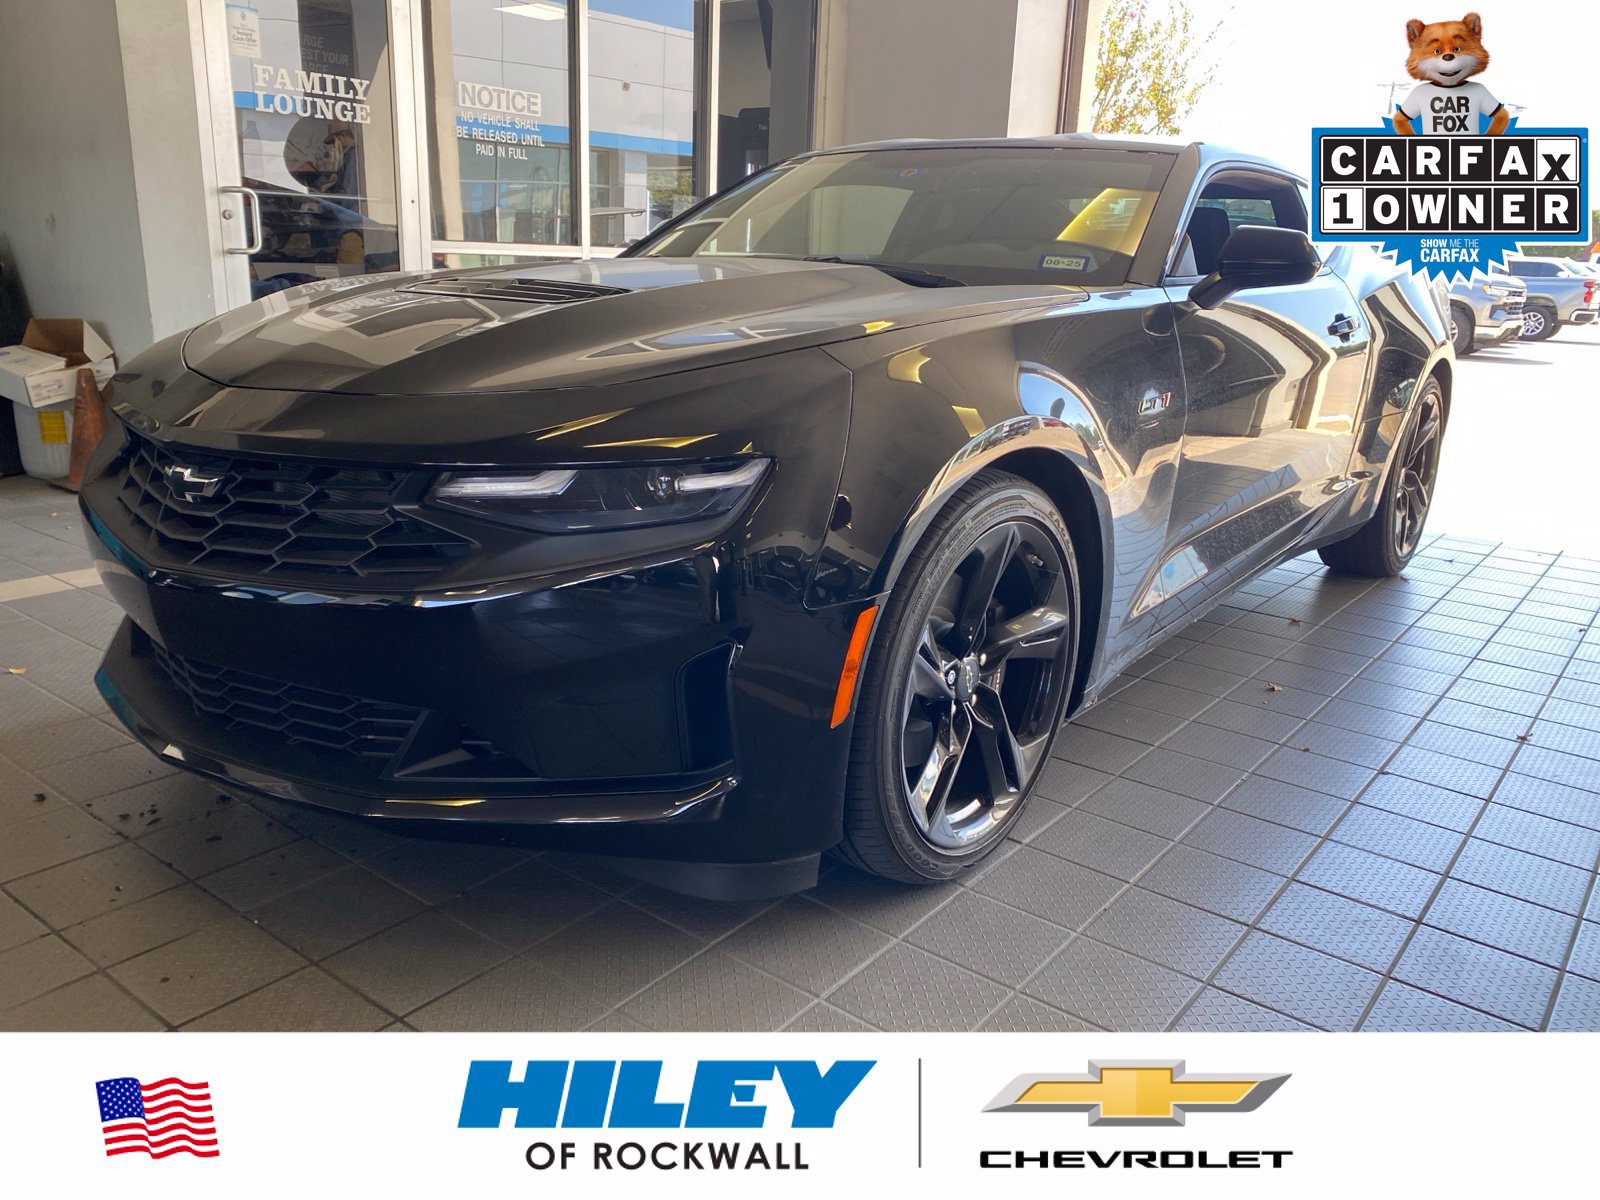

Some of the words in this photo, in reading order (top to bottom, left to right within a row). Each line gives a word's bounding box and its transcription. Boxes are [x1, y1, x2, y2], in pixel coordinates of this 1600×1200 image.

[321, 51, 349, 66] YOUR
[254, 64, 370, 100] FAMILY
[255, 90, 371, 124] LOUNGE
[461, 83, 540, 115] NOTICE
[461, 110, 474, 123] NO
[477, 113, 511, 128] VEHICLE
[514, 117, 540, 132] SHALL
[457, 126, 469, 139] BE
[472, 127, 517, 144] RELEASED
[521, 133, 545, 147] UNTIL
[476, 143, 494, 156] PAID
[497, 146, 505, 157] IN
[508, 148, 528, 160] FULL
